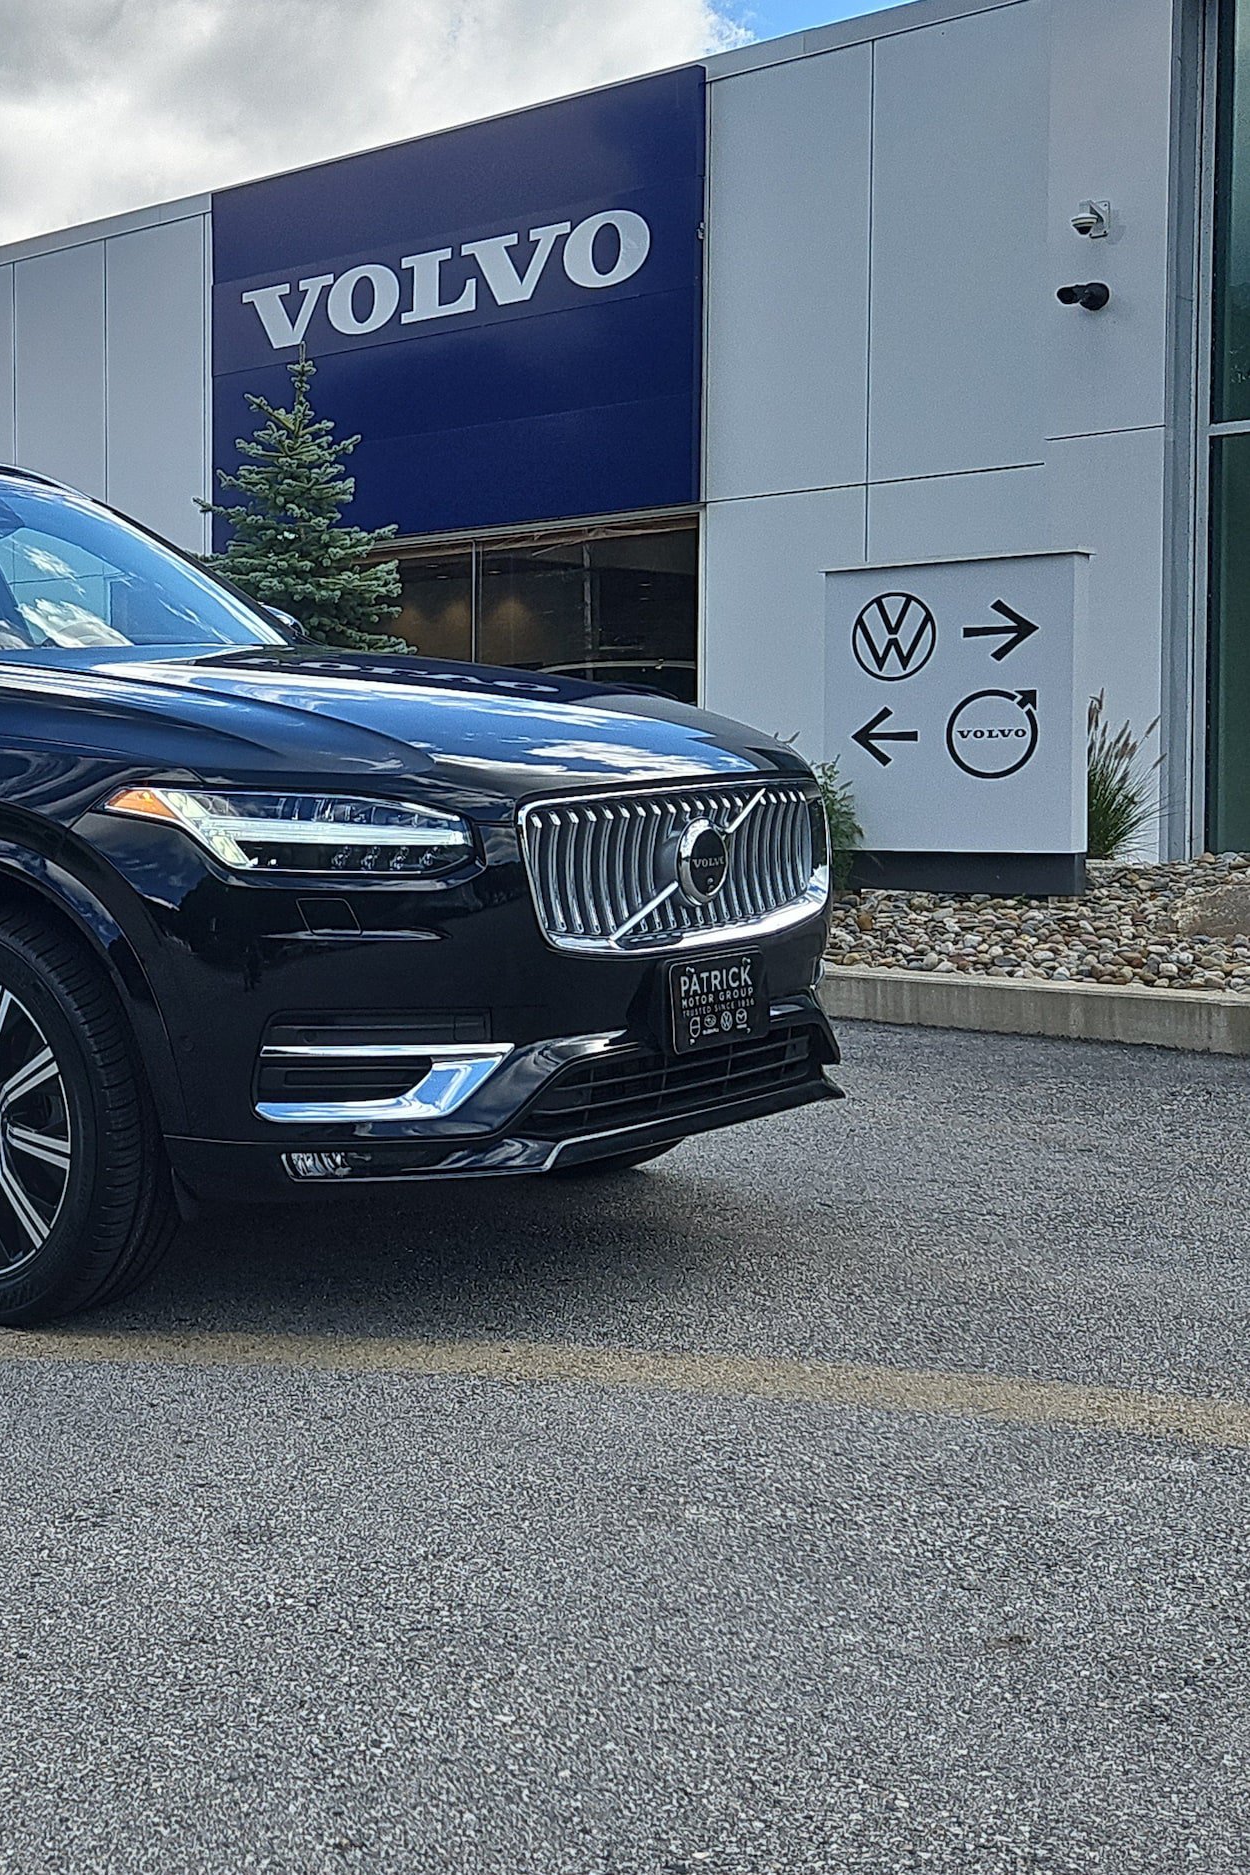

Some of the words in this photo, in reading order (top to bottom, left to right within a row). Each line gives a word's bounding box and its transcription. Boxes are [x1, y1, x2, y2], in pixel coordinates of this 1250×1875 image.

[242, 209, 651, 350] VOLVO
[957, 728, 1027, 739] VOLVO
[681, 965, 752, 997] PATRICK
[682, 993, 714, 1009] MOTOR
[719, 986, 754, 1001] GROUP
[683, 1006, 712, 1018] TRUSTED
[714, 1000, 735, 1013] SINCE
